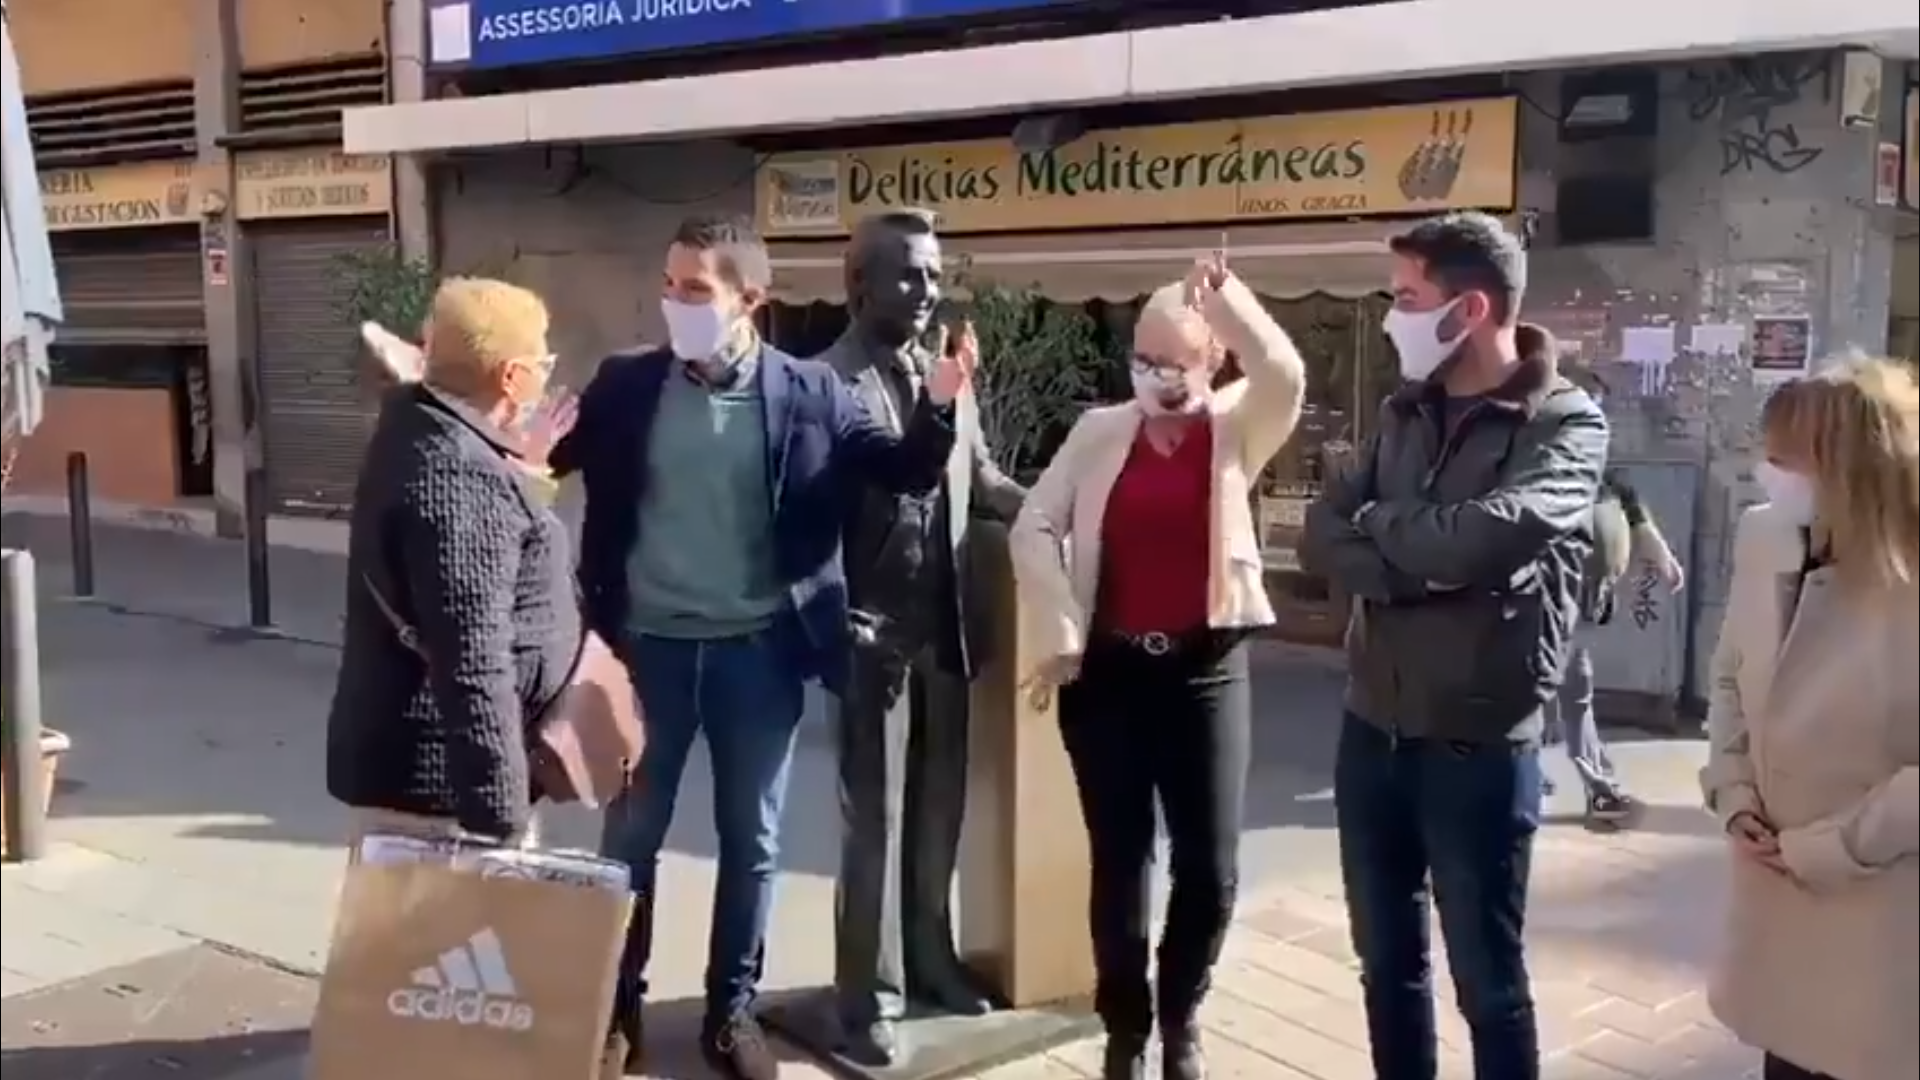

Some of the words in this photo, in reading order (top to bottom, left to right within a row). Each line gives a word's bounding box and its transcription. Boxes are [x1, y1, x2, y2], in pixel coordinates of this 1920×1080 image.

[478, 1, 624, 41] ASSESSORIA
[848, 155, 1000, 205] Delicias
[1017, 132, 1366, 197] Mediterráneas
[1300, 194, 1367, 211] GRACIA
[387, 983, 535, 1031] adidas
